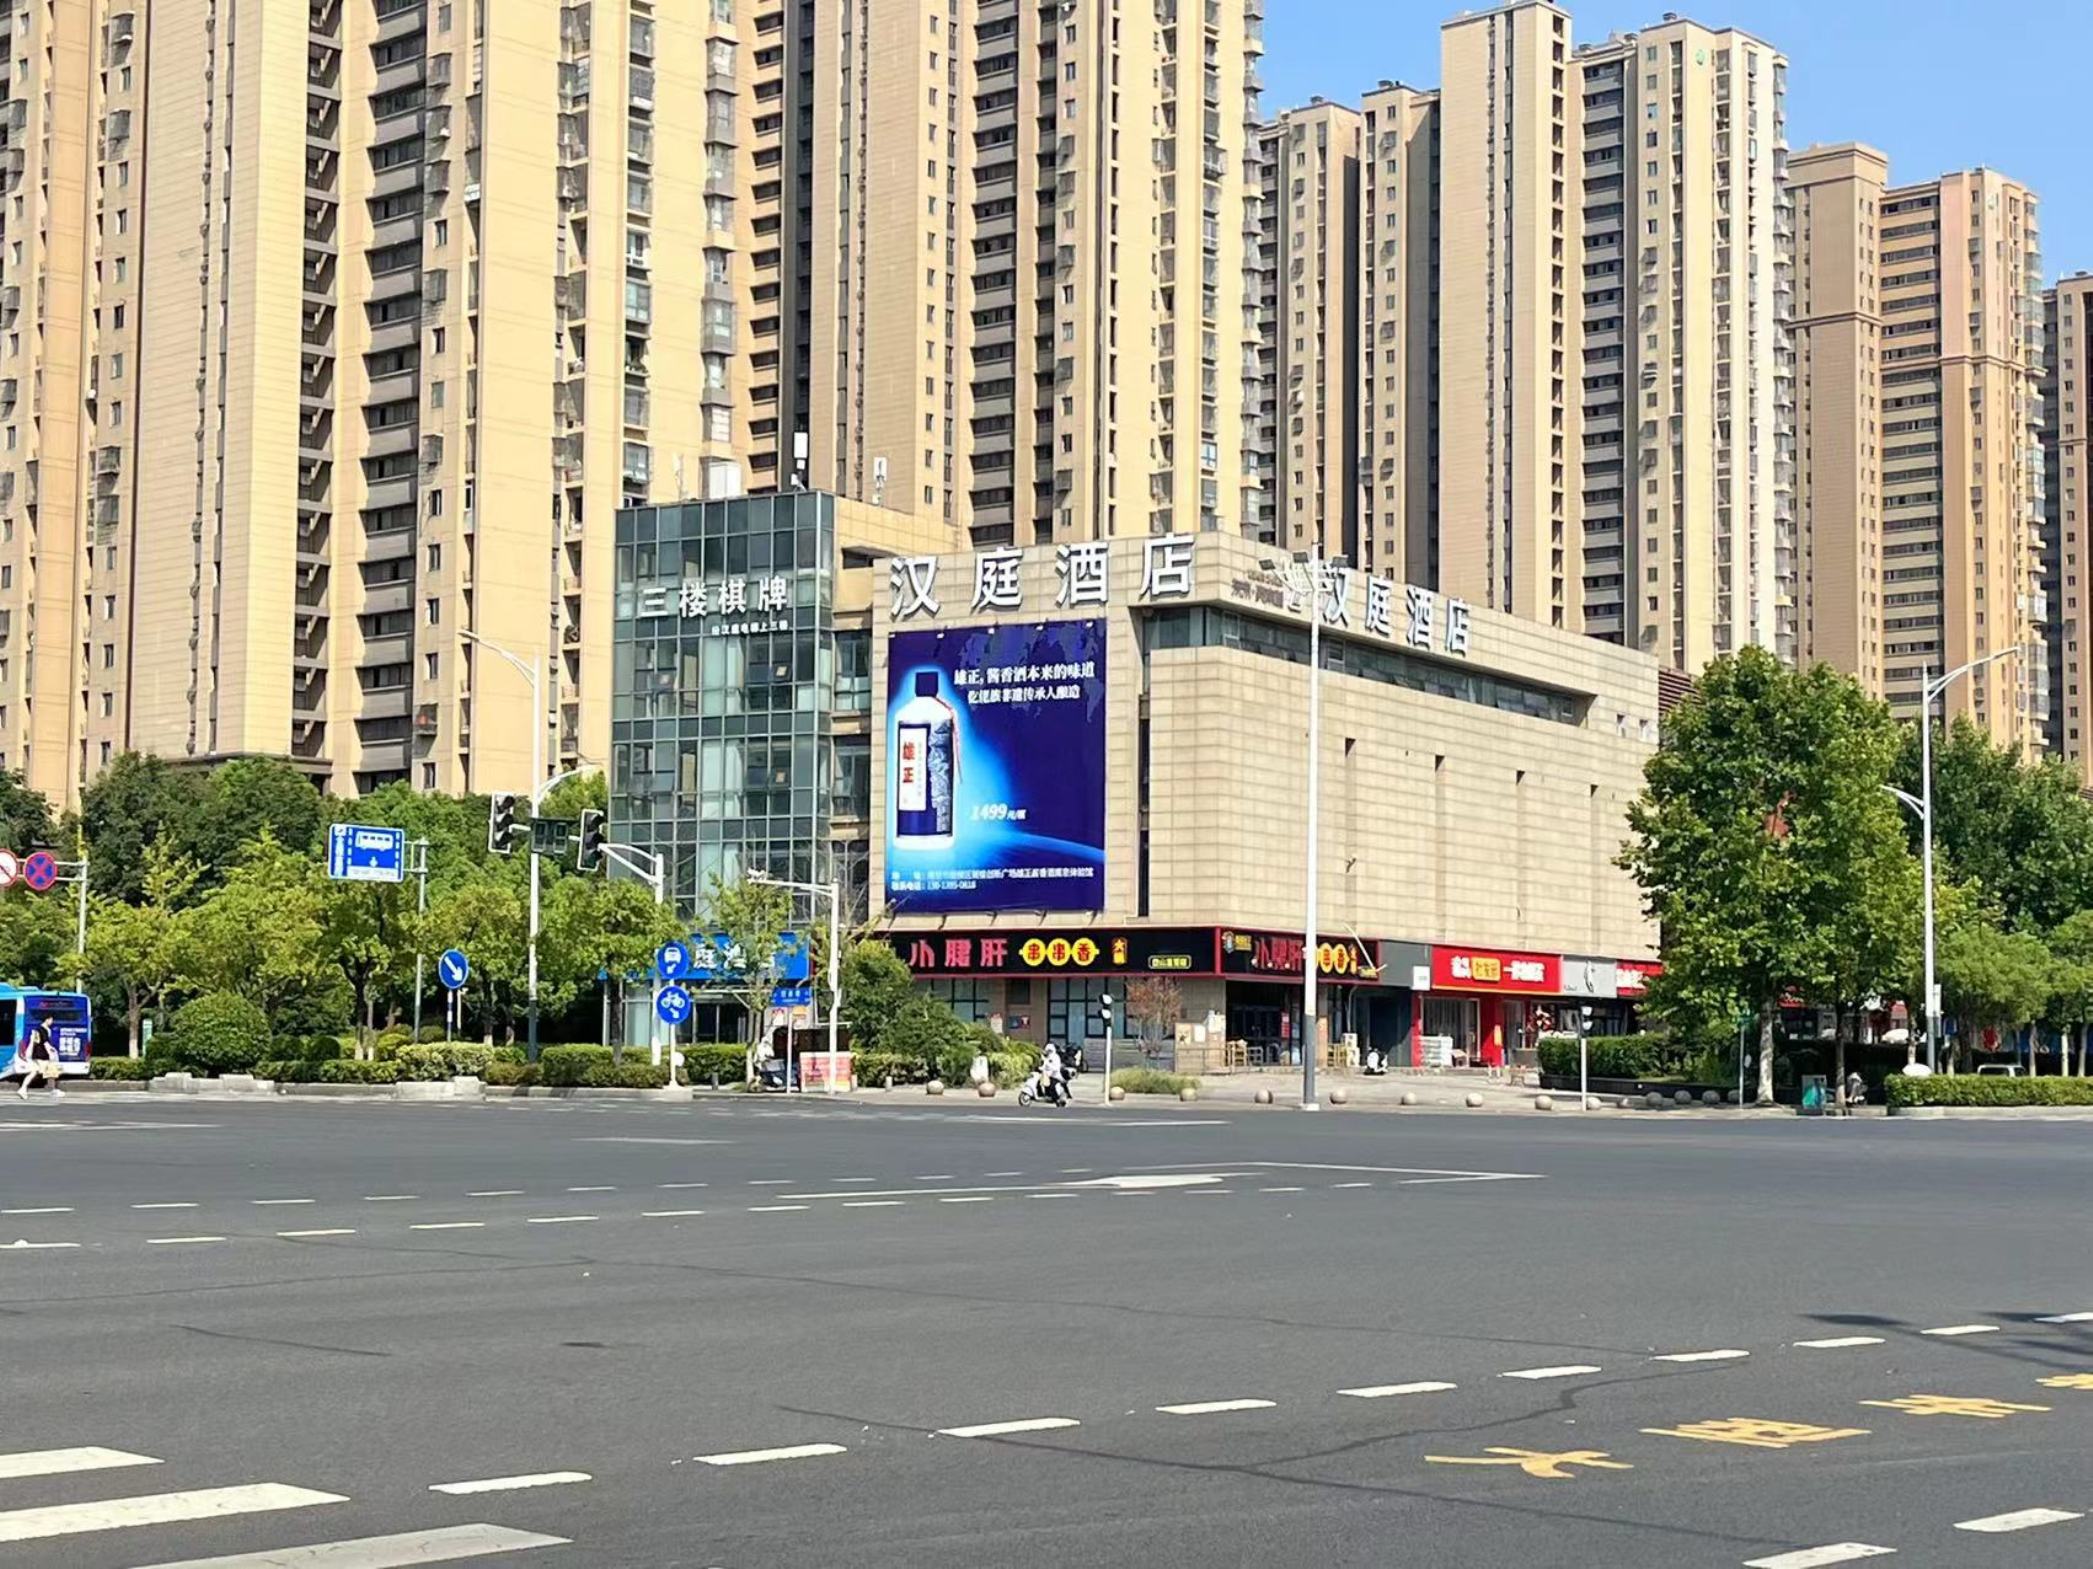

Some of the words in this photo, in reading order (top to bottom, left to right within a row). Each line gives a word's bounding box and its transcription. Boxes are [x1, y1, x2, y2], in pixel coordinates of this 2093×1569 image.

[639, 575, 789, 619] 三楼棋牌
[889, 533, 1196, 617] 汉庭酒店
[1322, 567, 1471, 656] 汉庭酒店
[1025, 941, 1093, 963] 串串香
